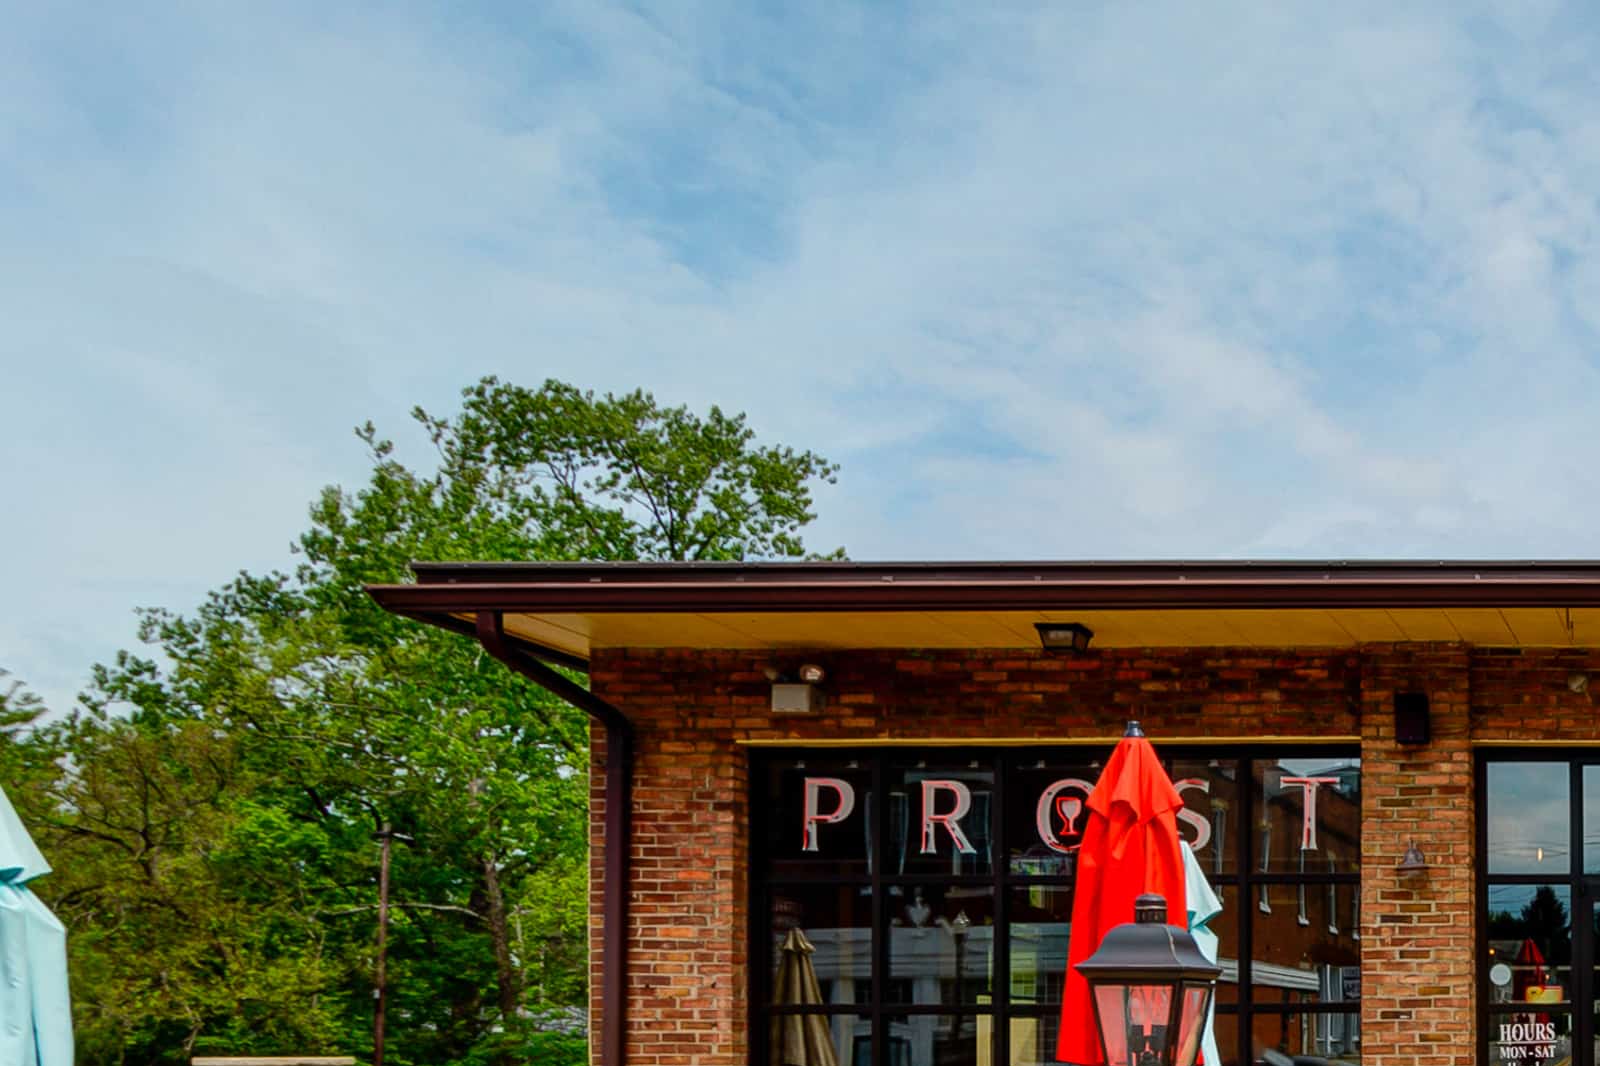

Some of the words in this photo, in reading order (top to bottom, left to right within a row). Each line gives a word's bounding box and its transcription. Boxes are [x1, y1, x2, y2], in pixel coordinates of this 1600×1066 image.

[801, 777, 1341, 854] PROST
[1499, 1023, 1556, 1041] HOURS
[1500, 1045, 1528, 1058] MON
[1535, 1045, 1557, 1058] SAT
